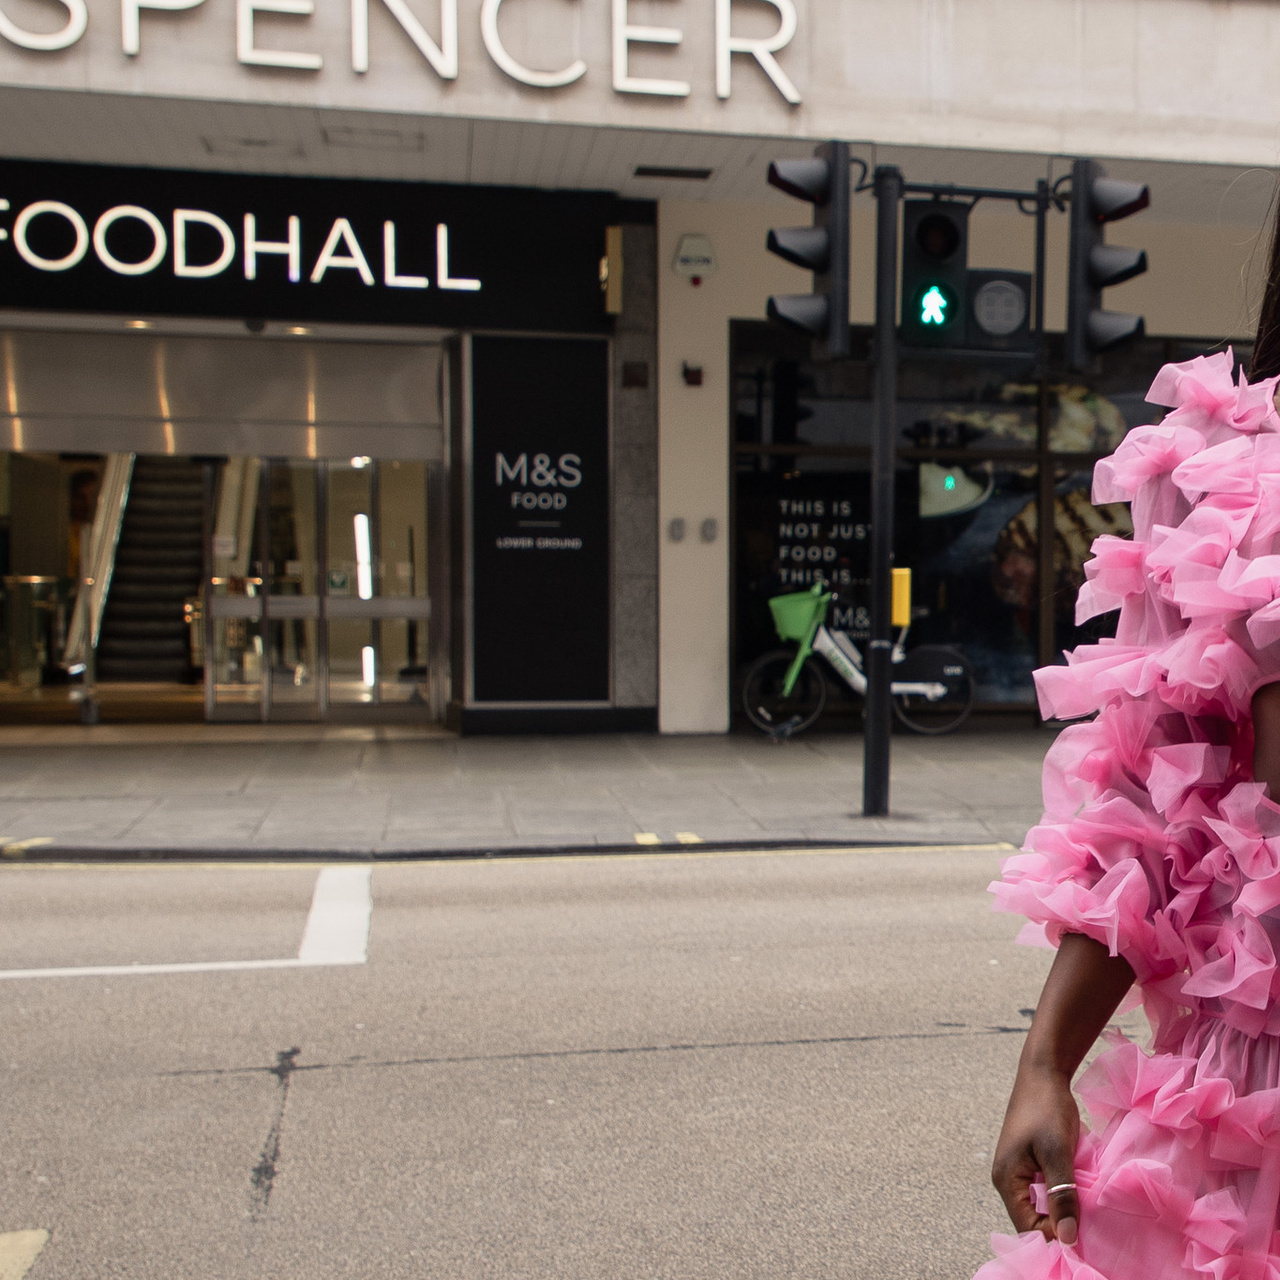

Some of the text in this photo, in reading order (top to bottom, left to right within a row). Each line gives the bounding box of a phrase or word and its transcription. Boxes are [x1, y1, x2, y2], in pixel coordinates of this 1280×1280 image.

[0, 199, 482, 291] OODHALL
[495, 452, 582, 488] M&S
[511, 492, 567, 510] FOOD
[780, 499, 851, 516] THIS IS
[779, 522, 872, 540] NOT JUS
[779, 545, 837, 562] FOOD
[780, 568, 824, 583] THIS
